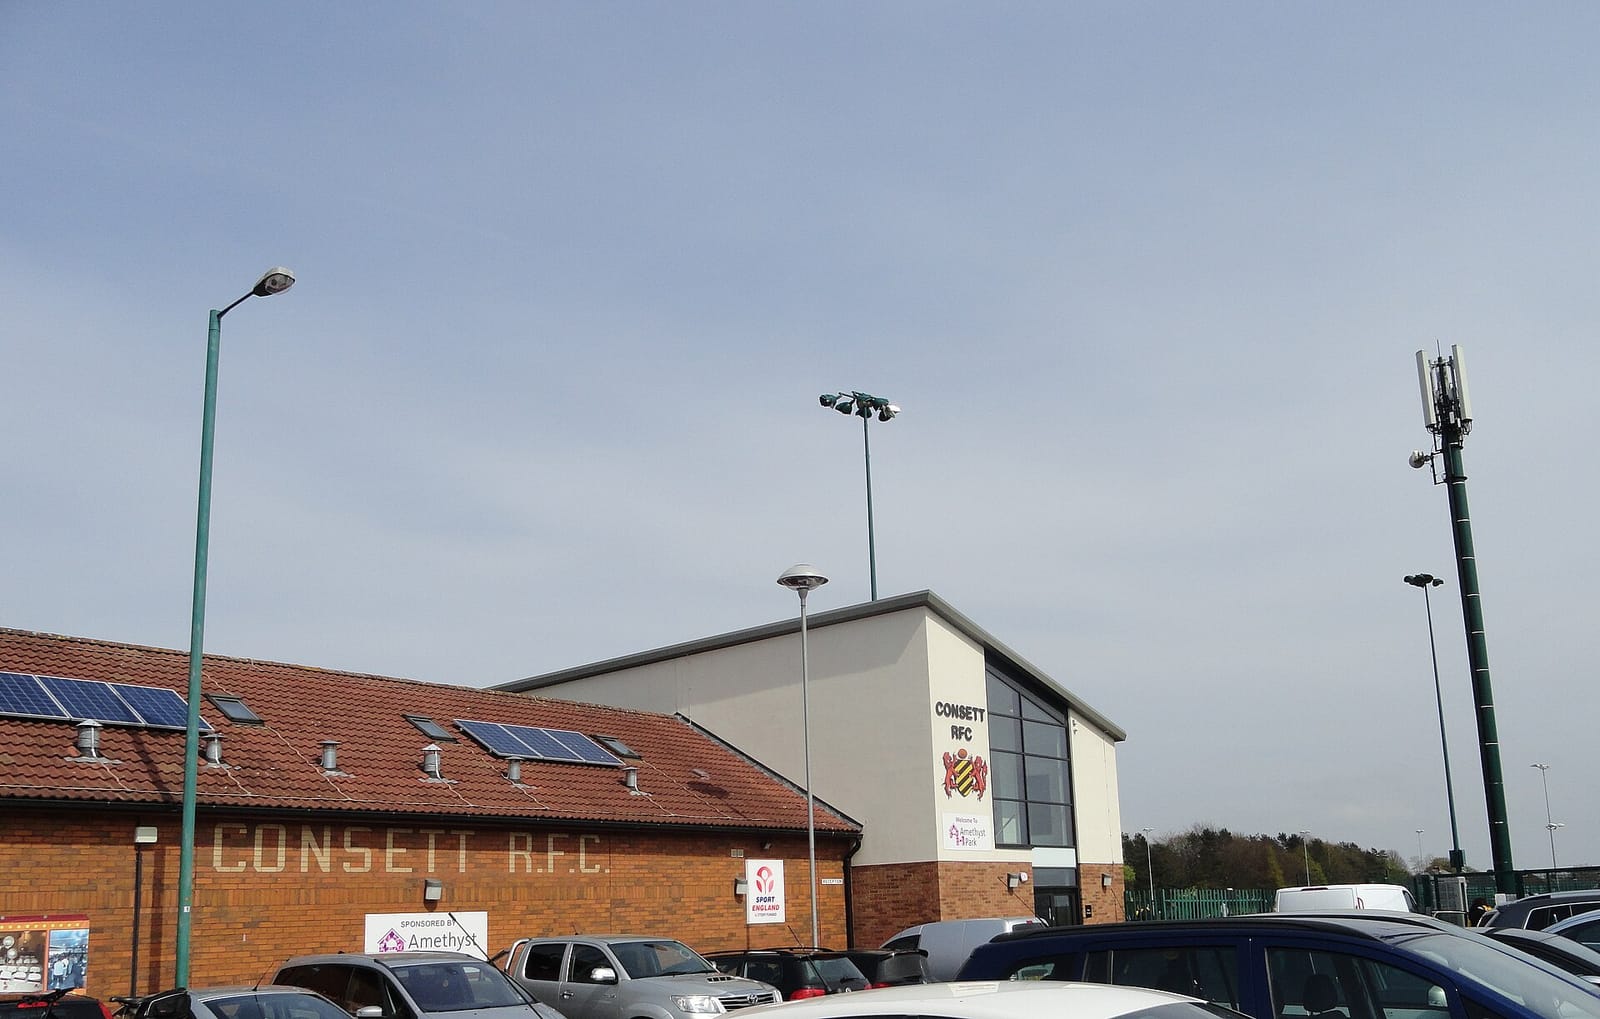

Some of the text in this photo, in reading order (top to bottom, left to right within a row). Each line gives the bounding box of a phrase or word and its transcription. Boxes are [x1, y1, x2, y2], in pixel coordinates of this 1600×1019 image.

[935, 701, 985, 722] CONSETT
[951, 725, 972, 742] RFC
[960, 827, 986, 838] Amethyst
[212, 823, 610, 873] CONSETT R.F.C.
[965, 837, 977, 847] Park
[752, 904, 780, 912] ENGLAND
[400, 919, 457, 929] SPONSORED BY
[408, 931, 477, 951] Amethyst
